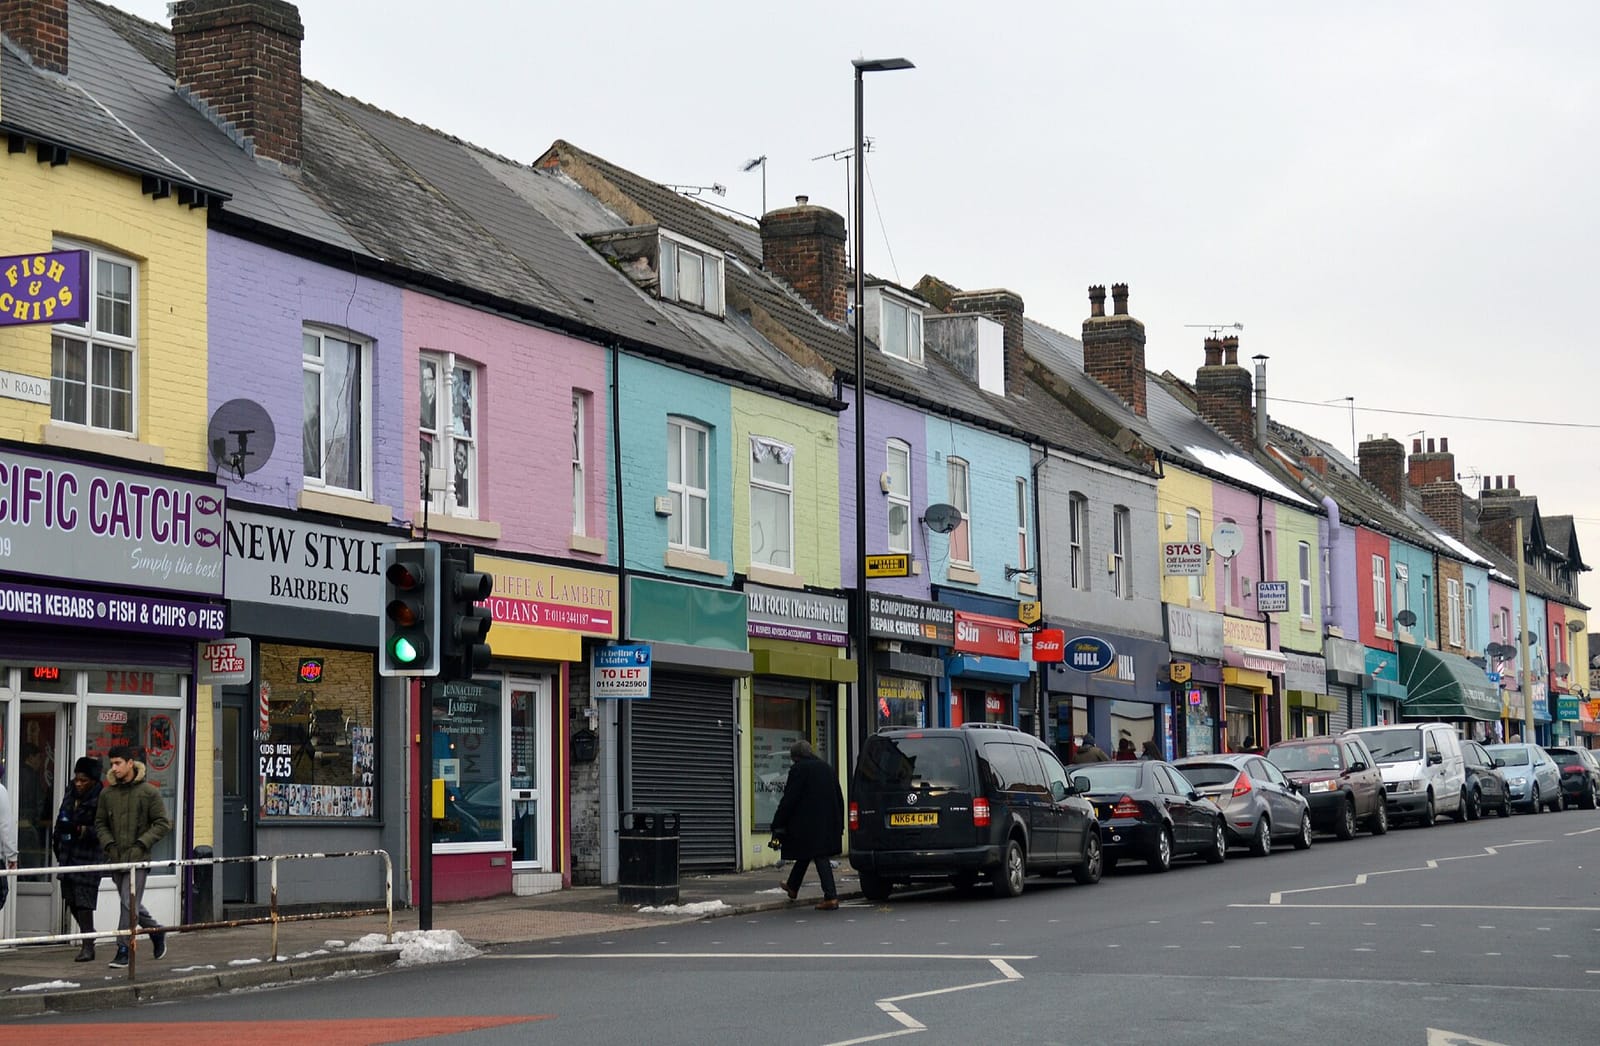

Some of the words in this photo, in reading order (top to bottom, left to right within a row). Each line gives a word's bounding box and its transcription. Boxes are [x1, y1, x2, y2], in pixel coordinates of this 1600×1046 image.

[5, 256, 65, 288] FISH
[28, 280, 42, 297] &
[0, 286, 73, 320] CHIPS
[15, 380, 42, 397] ROAD
[89, 476, 192, 548] CATCH
[226, 520, 296, 564] NEW
[1166, 544, 1202, 555] STA'S
[131, 547, 172, 581] Simply
[175, 554, 193, 576] the
[195, 557, 222, 579] best!
[270, 575, 349, 605] BARBERS
[494, 575, 531, 596] LIFFE
[535, 579, 544, 598] &
[550, 575, 613, 607] LAMBERT
[0, 590, 42, 614] DONER
[45, 594, 95, 620] KEBABS
[109, 600, 137, 623] FISH
[140, 605, 149, 624] &
[152, 604, 187, 628] CHIPS
[199, 609, 225, 631] PIES
[749, 593, 764, 612] TAX
[765, 595, 789, 616] FOCUS
[791, 599, 833, 624] (Yorkshire)
[833, 604, 846, 623] Ltd
[880, 600, 919, 619] COMPUTERS
[920, 606, 925, 619] &
[926, 608, 953, 624] MOBILES
[870, 616, 895, 633] REPAIR
[895, 620, 920, 636] CENTRE
[957, 621, 980, 643] Sun
[204, 644, 236, 660] JUST
[1035, 641, 1059, 651] Sun
[212, 658, 235, 671] EAT
[1074, 652, 1100, 666] HILL
[1118, 654, 1136, 681] HILL
[34, 666, 59, 680] OPEN
[105, 671, 154, 695] FISH
[601, 669, 617, 679] TO
[620, 669, 641, 679] LET
[596, 680, 614, 688] 0114
[447, 698, 478, 716] LAMBERT
[259, 744, 274, 755] KIDS
[276, 744, 292, 755] MEN
[259, 756, 275, 777] £4
[275, 757, 292, 778] £5
[894, 814, 915, 823] NK64
